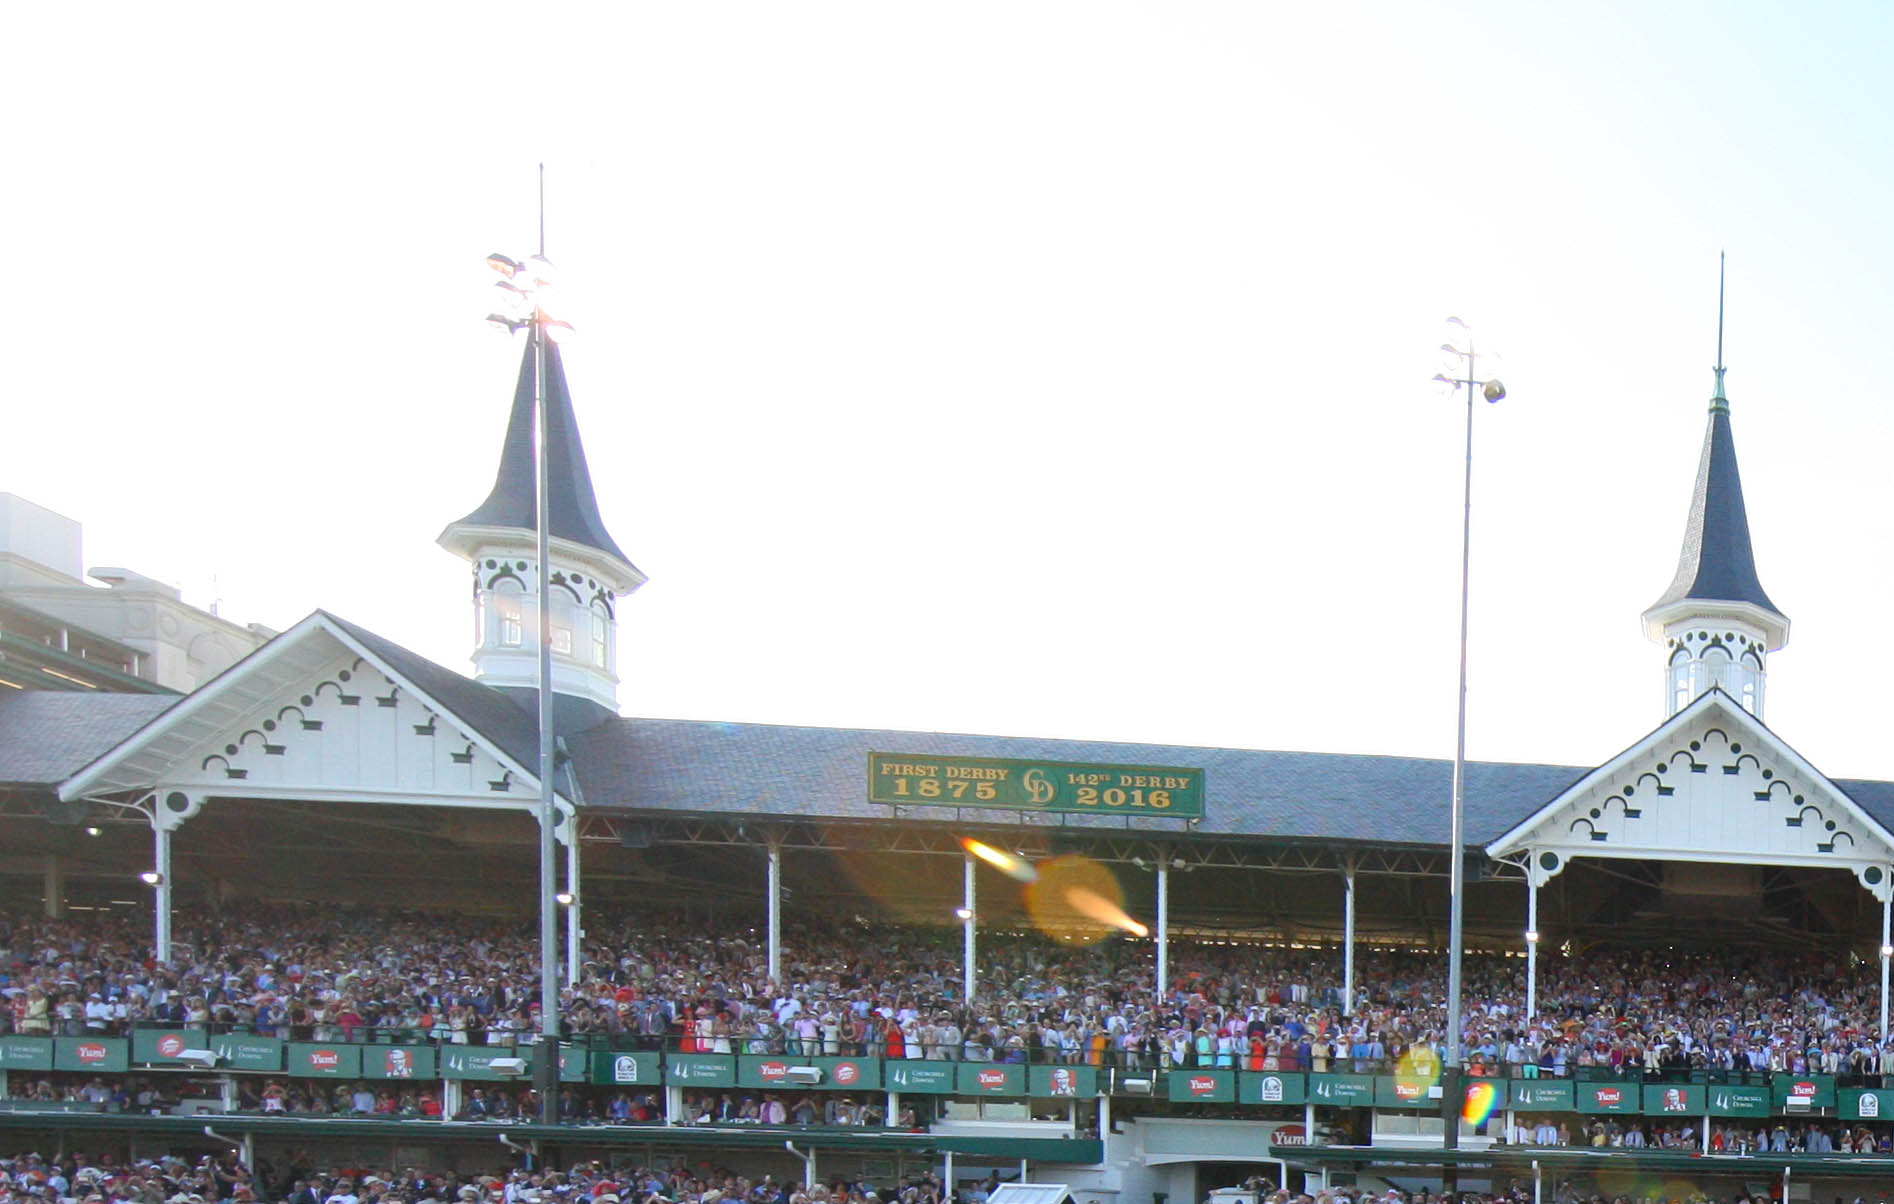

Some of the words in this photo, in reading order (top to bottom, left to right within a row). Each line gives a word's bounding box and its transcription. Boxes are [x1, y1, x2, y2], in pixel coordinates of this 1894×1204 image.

[881, 763, 939, 777] FIRST
[946, 766, 1009, 781] DERBY
[1120, 775, 1190, 790] DERBY
[894, 778, 997, 800] 1875
[1076, 788, 1172, 809] 2016
[78, 1046, 107, 1058] Yum!
[311, 1053, 338, 1064] Yum!
[761, 1065, 786, 1075] Yum!
[978, 1071, 1005, 1083] Yum!
[1190, 1078, 1214, 1090] Yum!
[1793, 1085, 1816, 1095] Yum!
[1396, 1085, 1420, 1096] Yum!
[1598, 1091, 1621, 1101] Yum!
